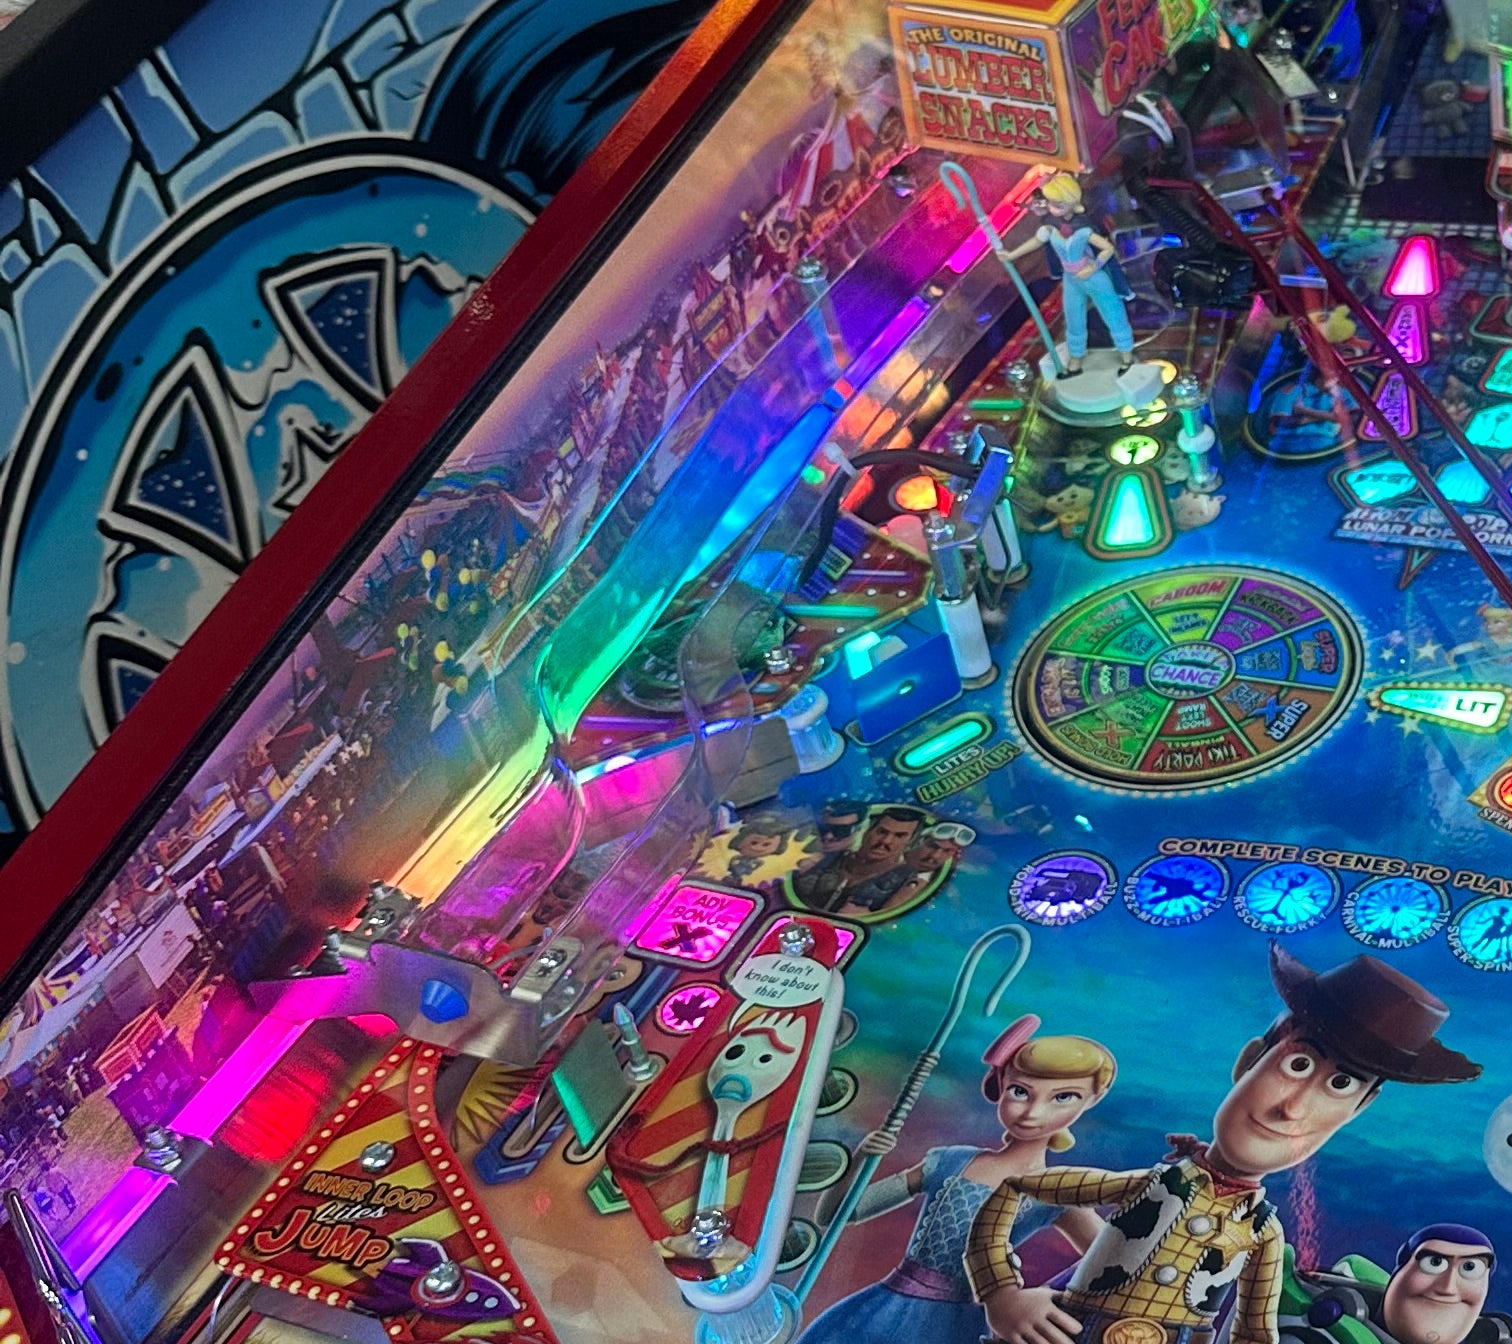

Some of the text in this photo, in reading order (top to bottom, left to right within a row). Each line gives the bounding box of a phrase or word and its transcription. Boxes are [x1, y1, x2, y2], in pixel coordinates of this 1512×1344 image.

[907, 26, 1046, 63] THE ORIGINAL
[906, 42, 1056, 108] LUMBER
[918, 91, 1061, 156] SNACKS
[1151, 663, 1221, 687] CHANCE
[1269, 699, 1310, 742] SUPER
[1455, 698, 1498, 714] LIT
[934, 747, 981, 775] LITES
[921, 761, 985, 800] HURRY
[1160, 838, 1300, 862] COMPLETE
[1302, 848, 1405, 877] SCENES
[1412, 861, 1450, 886] TO
[671, 905, 730, 929] BONUS
[1233, 895, 1270, 933] RESCUE
[1341, 890, 1451, 950] CARNIVAL MULTIBALL
[1446, 923, 1470, 967] SUPER
[744, 969, 820, 992] know about
[779, 959, 814, 977] don't
[755, 986, 786, 1000] this!
[303, 1172, 435, 1213] INNER LOOP
[316, 1201, 389, 1223] Lites
[253, 1208, 391, 1267] JUMP
